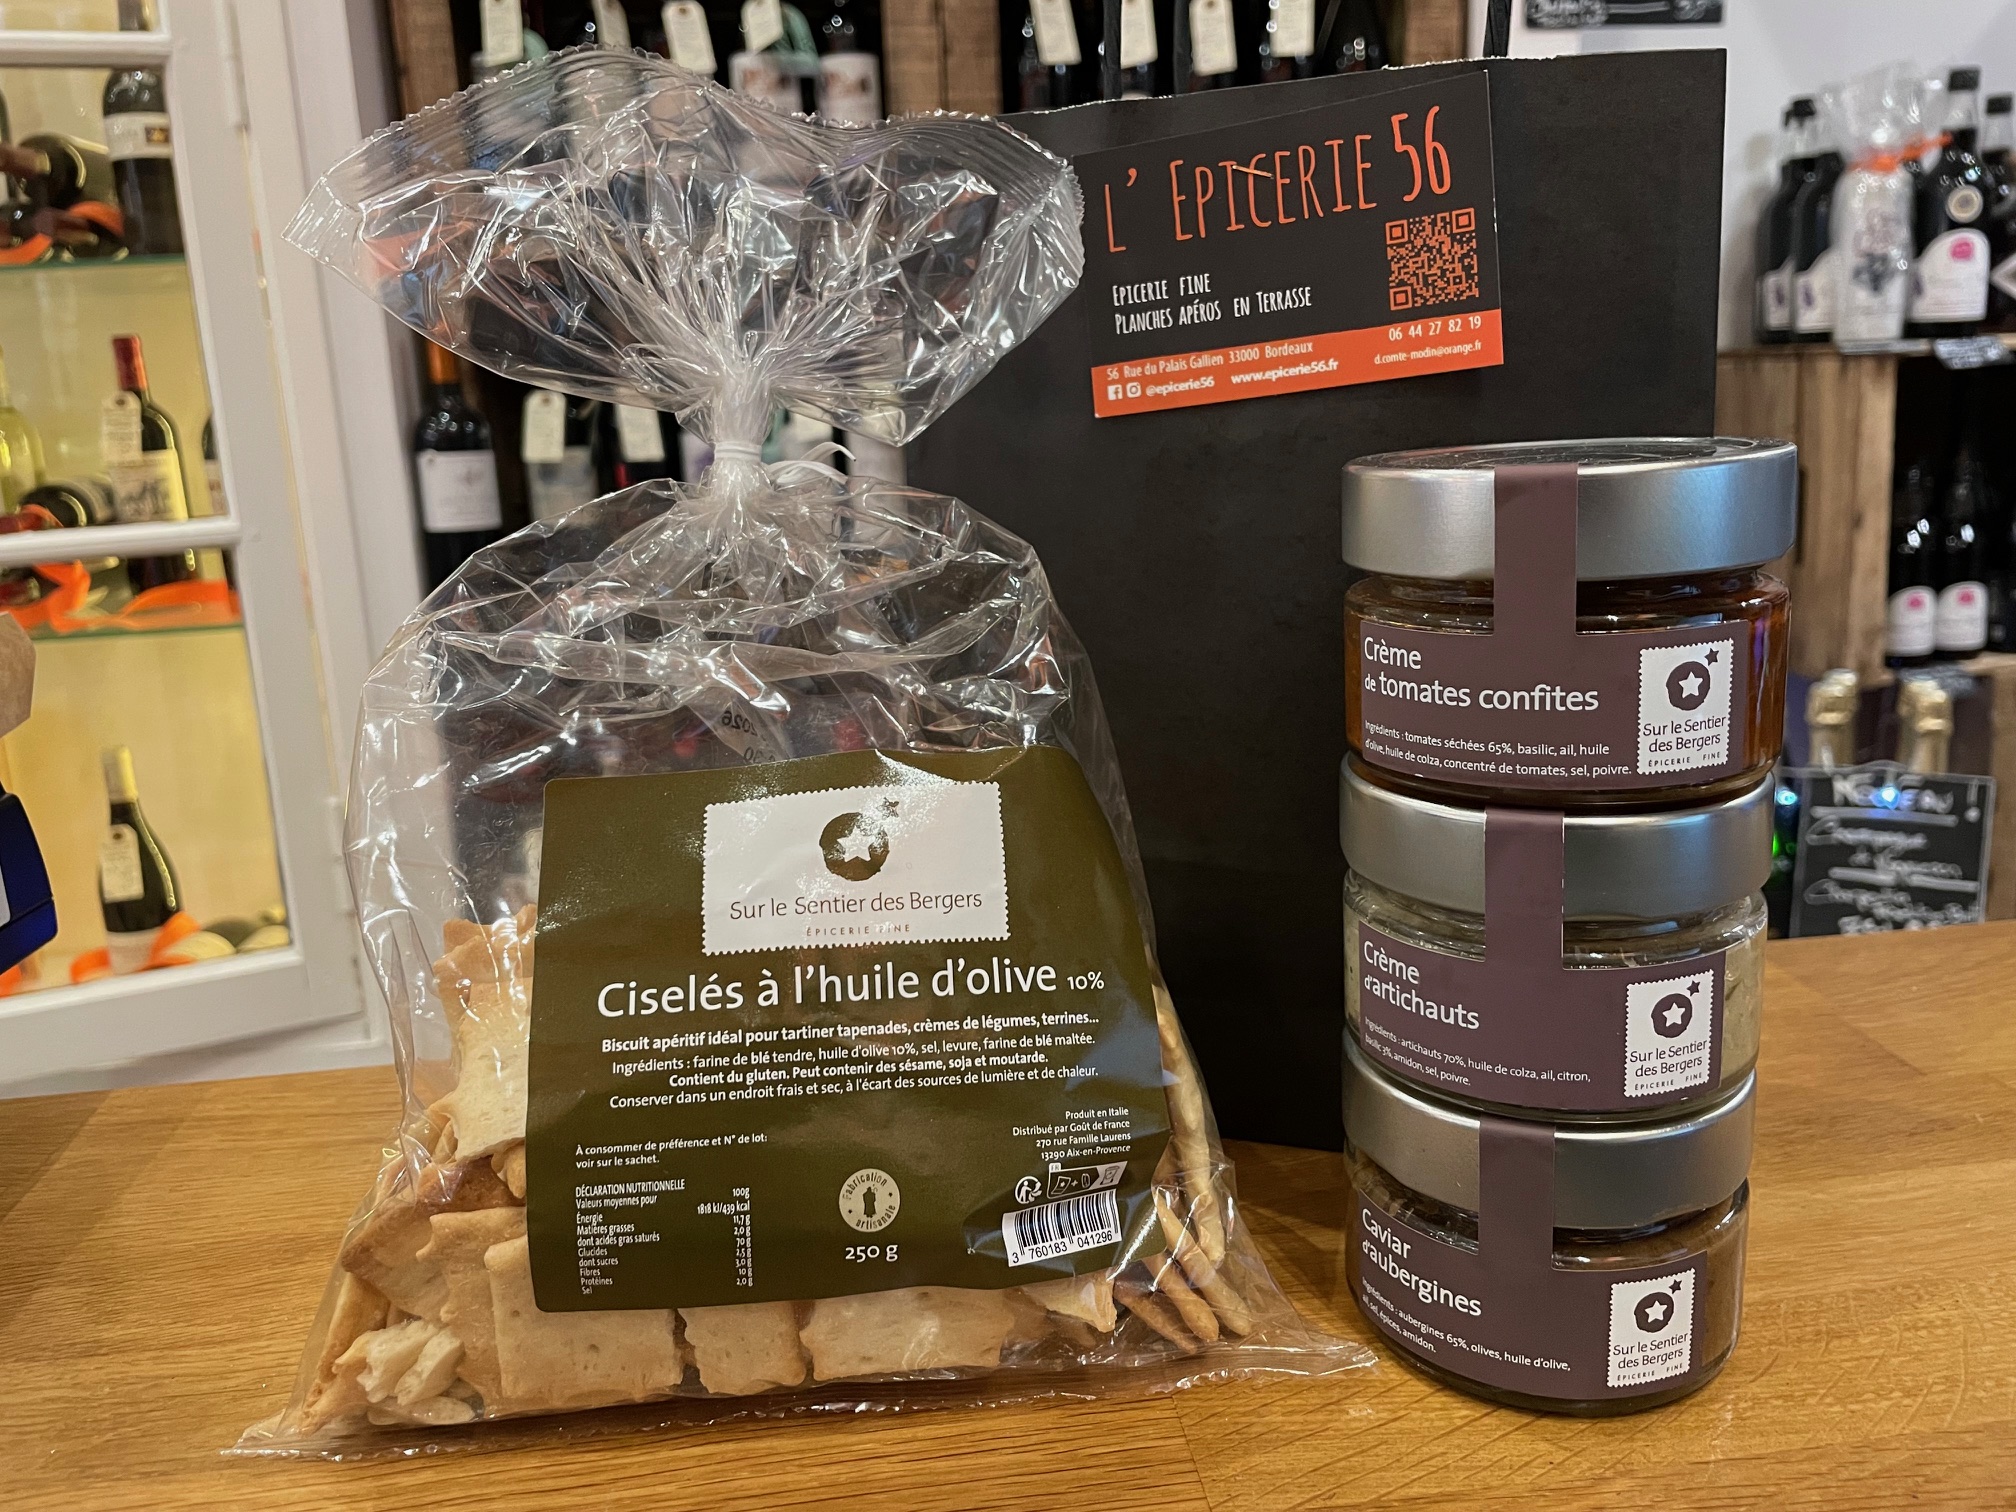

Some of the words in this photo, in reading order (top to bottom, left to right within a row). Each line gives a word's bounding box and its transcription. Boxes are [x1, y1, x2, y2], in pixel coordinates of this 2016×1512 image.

[1169, 134, 1378, 242] EPICERIE
[1391, 105, 1452, 202] 56
[1389, 327, 1403, 341] 06
[1408, 322, 1422, 338] 44
[1429, 321, 1442, 336] 27
[1448, 318, 1462, 332] 82
[1468, 315, 1481, 329] 19
[1106, 367, 1119, 380] 56
[1123, 365, 1142, 378] Rue
[1144, 362, 1157, 375] du
[1158, 358, 1188, 373] Palais
[1189, 354, 1224, 369] Gallien
[1228, 347, 1260, 363] 33000
[1264, 342, 1313, 358] Bordeaux
[1231, 358, 1339, 384] www.epicerie56.fr
[1146, 376, 1215, 397] @epicerie56
[1364, 636, 1421, 669] Crème
[1364, 673, 1376, 692] de
[1378, 671, 1471, 707] tomates
[1479, 684, 1599, 711] confites
[1643, 723, 1668, 737] Sur
[1671, 720, 1682, 734] le
[1684, 715, 1726, 733] Sentier
[1405, 732, 1442, 746] tomates
[1444, 738, 1485, 751] séchées
[1488, 742, 1515, 755] 65%,
[1518, 743, 1557, 756] basilic,
[1560, 744, 1576, 756] ail,
[1580, 744, 1609, 755] huile
[1648, 738, 1673, 753] des
[1676, 733, 1721, 751] Bergers
[1385, 746, 1404, 759] huile
[1404, 750, 1416, 762] de
[1416, 754, 1443, 768] colza,
[1443, 759, 1496, 773] concentré
[1498, 762, 1513, 774] de
[1515, 764, 1568, 777] tomates,
[1570, 764, 1591, 778] sel,
[1592, 764, 1632, 778] poivre.
[1648, 756, 1691, 767] ÉPICERIE
[1702, 751, 1720, 761] FINE
[730, 901, 766, 920] Sur
[771, 897, 787, 917] le
[794, 894, 866, 915] Sentier
[871, 892, 905, 912] des
[910, 892, 982, 915] Bergers
[806, 926, 869, 937] ÉPICERIE
[1364, 941, 1420, 984] Crème
[598, 973, 744, 1017] Ciselés
[757, 969, 778, 1012] à
[795, 961, 919, 1004] l'huile
[932, 957, 1057, 997] d'olive
[1067, 971, 1104, 990] 10%
[1364, 974, 1479, 1029] d'artichauts
[602, 1036, 650, 1052] Biscuit
[652, 1031, 706, 1052] apéritif
[708, 1029, 742, 1045] idéal
[745, 1030, 779, 1047] pour
[781, 1025, 835, 1040] tartiner
[836, 1020, 911, 1041] tapenades,
[913, 1018, 960, 1032] crèmes
[963, 1016, 979, 1030] de
[981, 1015, 1040, 1032] légumes,
[1041, 1011, 1099, 1025] terrines...
[1401, 1039, 1442, 1060] artichauts
[1443, 1053, 1466, 1068] 70%,
[1468, 1057, 1493, 1072] huile
[1494, 1063, 1508, 1075] de
[1509, 1067, 1539, 1080] colza,
[1540, 1070, 1555, 1082] ail,
[1557, 1071, 1591, 1082] citron,
[1630, 1051, 1653, 1063] Sur
[1656, 1048, 1666, 1060] le
[1668, 1040, 1707, 1058] Sentier
[669, 1072, 725, 1087] Contient
[727, 1070, 743, 1083] du
[746, 1068, 790, 1084] gluten.
[793, 1065, 821, 1079] Peut
[823, 1062, 874, 1076] contenir
[875, 1061, 896, 1073] des
[899, 1059, 946, 1072] sésame,
[948, 1056, 972, 1071] soja
[974, 1055, 987, 1067] et
[989, 1052, 1048, 1066] moutarde.
[1635, 1064, 1658, 1077] des
[1660, 1056, 1703, 1074] Bergers
[1634, 1079, 1674, 1091] ÉPICERIE
[1685, 1072, 1702, 1082] FINE
[1065, 1109, 1095, 1120] Produit
[1108, 1107, 1129, 1117] Italie
[1013, 1124, 1052, 1136] Distribué
[1054, 1125, 1068, 1134] par
[1069, 1122, 1091, 1132] Goût
[1092, 1121, 1102, 1130] de
[1104, 1120, 1130, 1129] France
[1036, 1139, 1051, 1148] 270
[1053, 1138, 1067, 1146] rue
[1069, 1133, 1099, 1144] Famille
[1100, 1133, 1131, 1142] Laurens
[576, 1144, 583, 1156] À
[585, 1144, 643, 1155] consommer
[644, 1141, 657, 1151] de
[659, 1138, 710, 1152] préférence
[711, 1136, 721, 1146] et
[738, 1134, 750, 1144] de
[752, 1133, 767, 1143] lot:
[1041, 1151, 1065, 1161] 13290
[1066, 1145, 1131, 1158] Aix-en-Provence
[576, 1159, 594, 1169] voir
[597, 1159, 612, 1167] sur
[614, 1156, 623, 1166] le
[625, 1154, 659, 1165] sachet.
[575, 1183, 625, 1198] DÉCLARATION
[626, 1179, 685, 1193] NUTRITIONNELLE
[842, 1172, 887, 1201] Fabrication
[856, 1204, 896, 1230] artisanale
[1362, 1208, 1411, 1259] Caviar
[845, 1245, 880, 1263] 250
[885, 1244, 898, 1262] g
[1012, 1252, 1020, 1264] 3
[1028, 1241, 1068, 1260] 760183
[1077, 1230, 1113, 1248] 041296
[1362, 1239, 1481, 1316] d'aubergines
[1398, 1310, 1445, 1340] aubergines
[1446, 1333, 1469, 1351] 65%,
[1471, 1344, 1502, 1361] olives,
[1504, 1351, 1531, 1366] huile
[1533, 1357, 1571, 1371] d'olive,
[1613, 1344, 1635, 1356] Sur
[1638, 1341, 1648, 1353] le
[1649, 1333, 1688, 1351] Sentier
[1618, 1357, 1639, 1369] des
[1642, 1348, 1683, 1366] Bergers
[1617, 1370, 1655, 1381] ÉPICERIE
[1666, 1362, 1683, 1373] FINE
